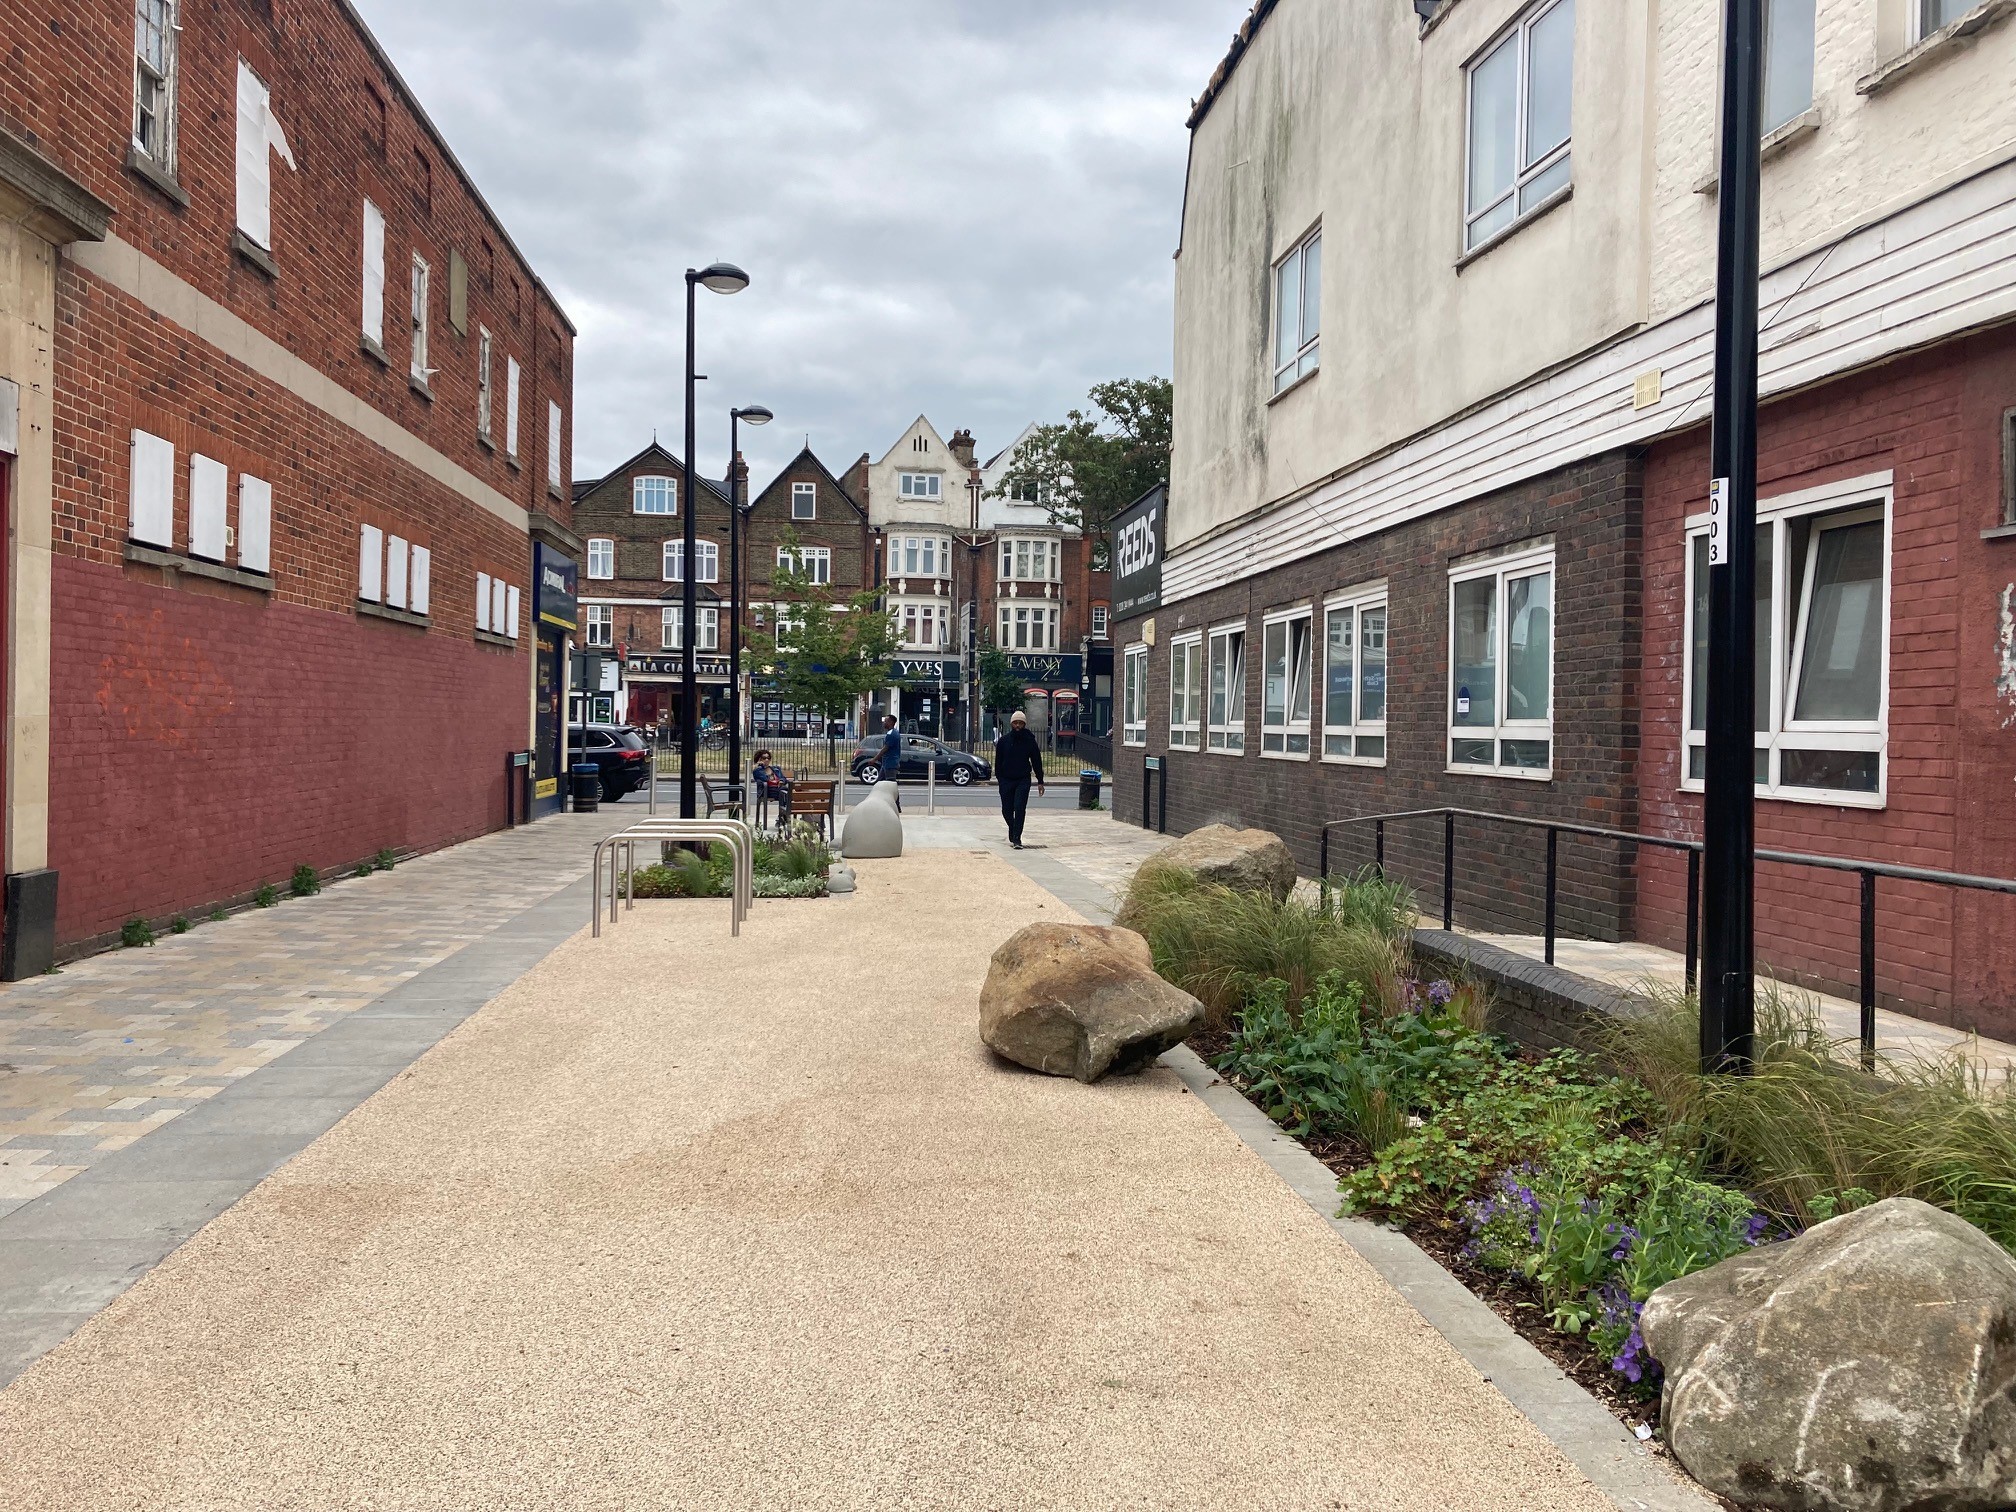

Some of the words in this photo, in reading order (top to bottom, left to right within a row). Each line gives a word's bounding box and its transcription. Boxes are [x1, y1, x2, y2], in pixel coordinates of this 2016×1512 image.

[1119, 507, 1156, 578] REEDS
[642, 662, 658, 672] LA
[899, 661, 942, 676] YVES
